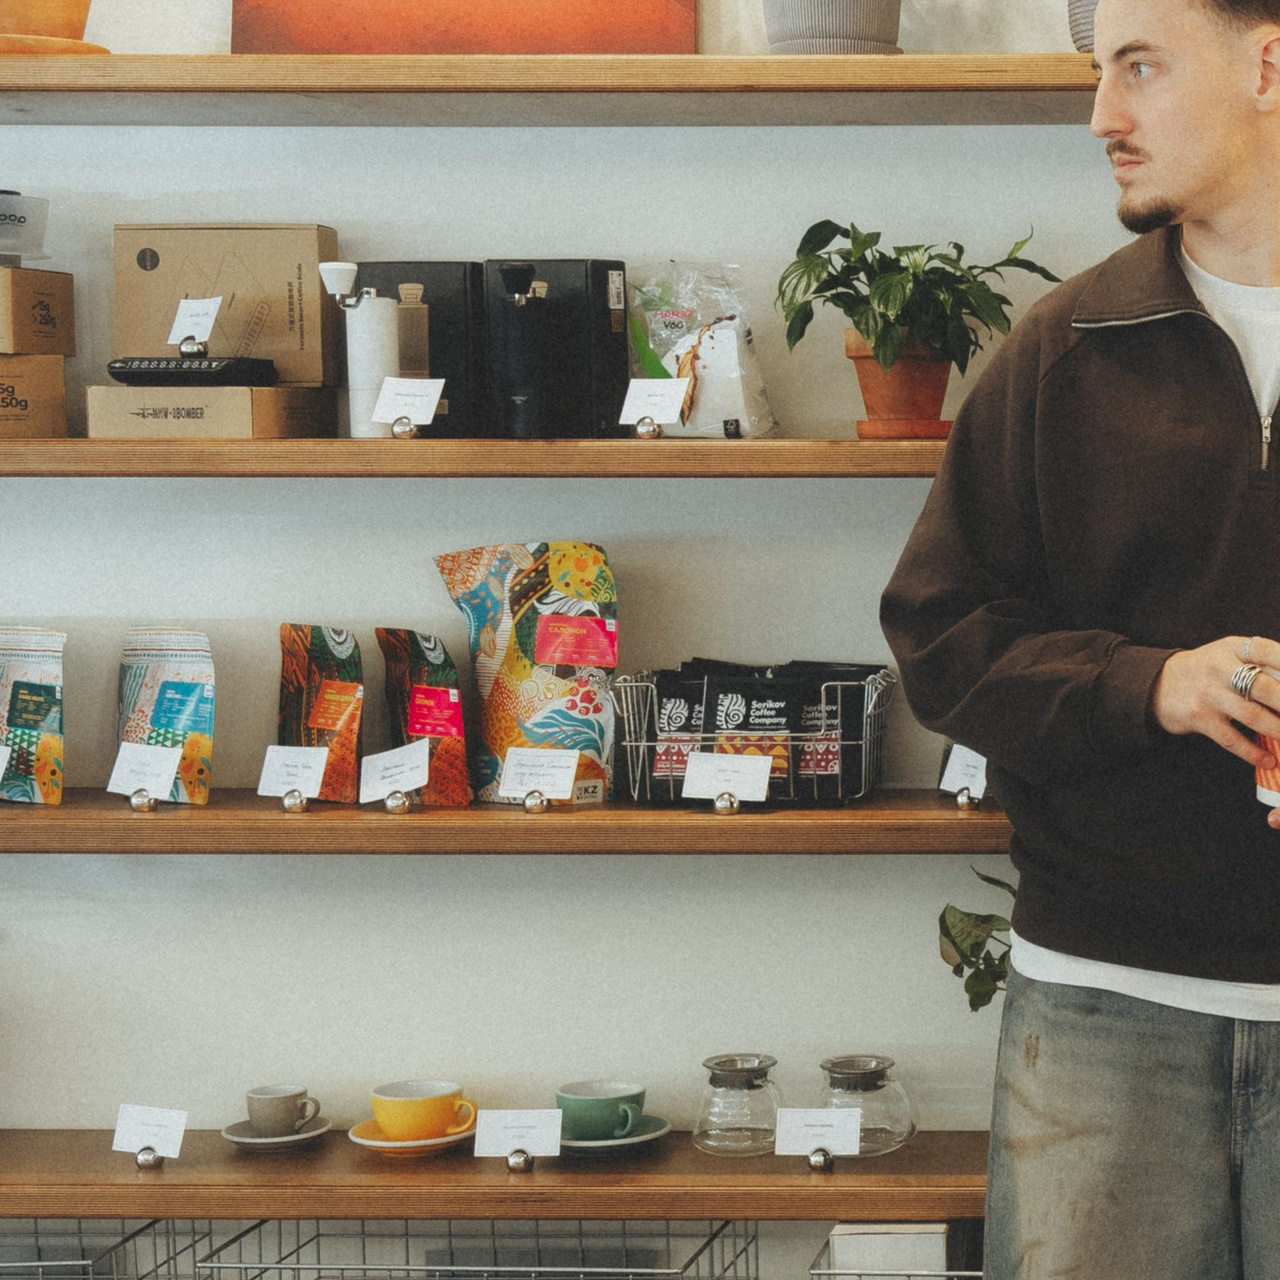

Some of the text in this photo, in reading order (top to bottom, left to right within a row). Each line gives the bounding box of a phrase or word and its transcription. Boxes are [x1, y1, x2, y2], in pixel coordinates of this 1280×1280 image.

[751, 699, 786, 709] Serikov
[750, 708, 777, 716] Coffee
[748, 716, 788, 725] Company
